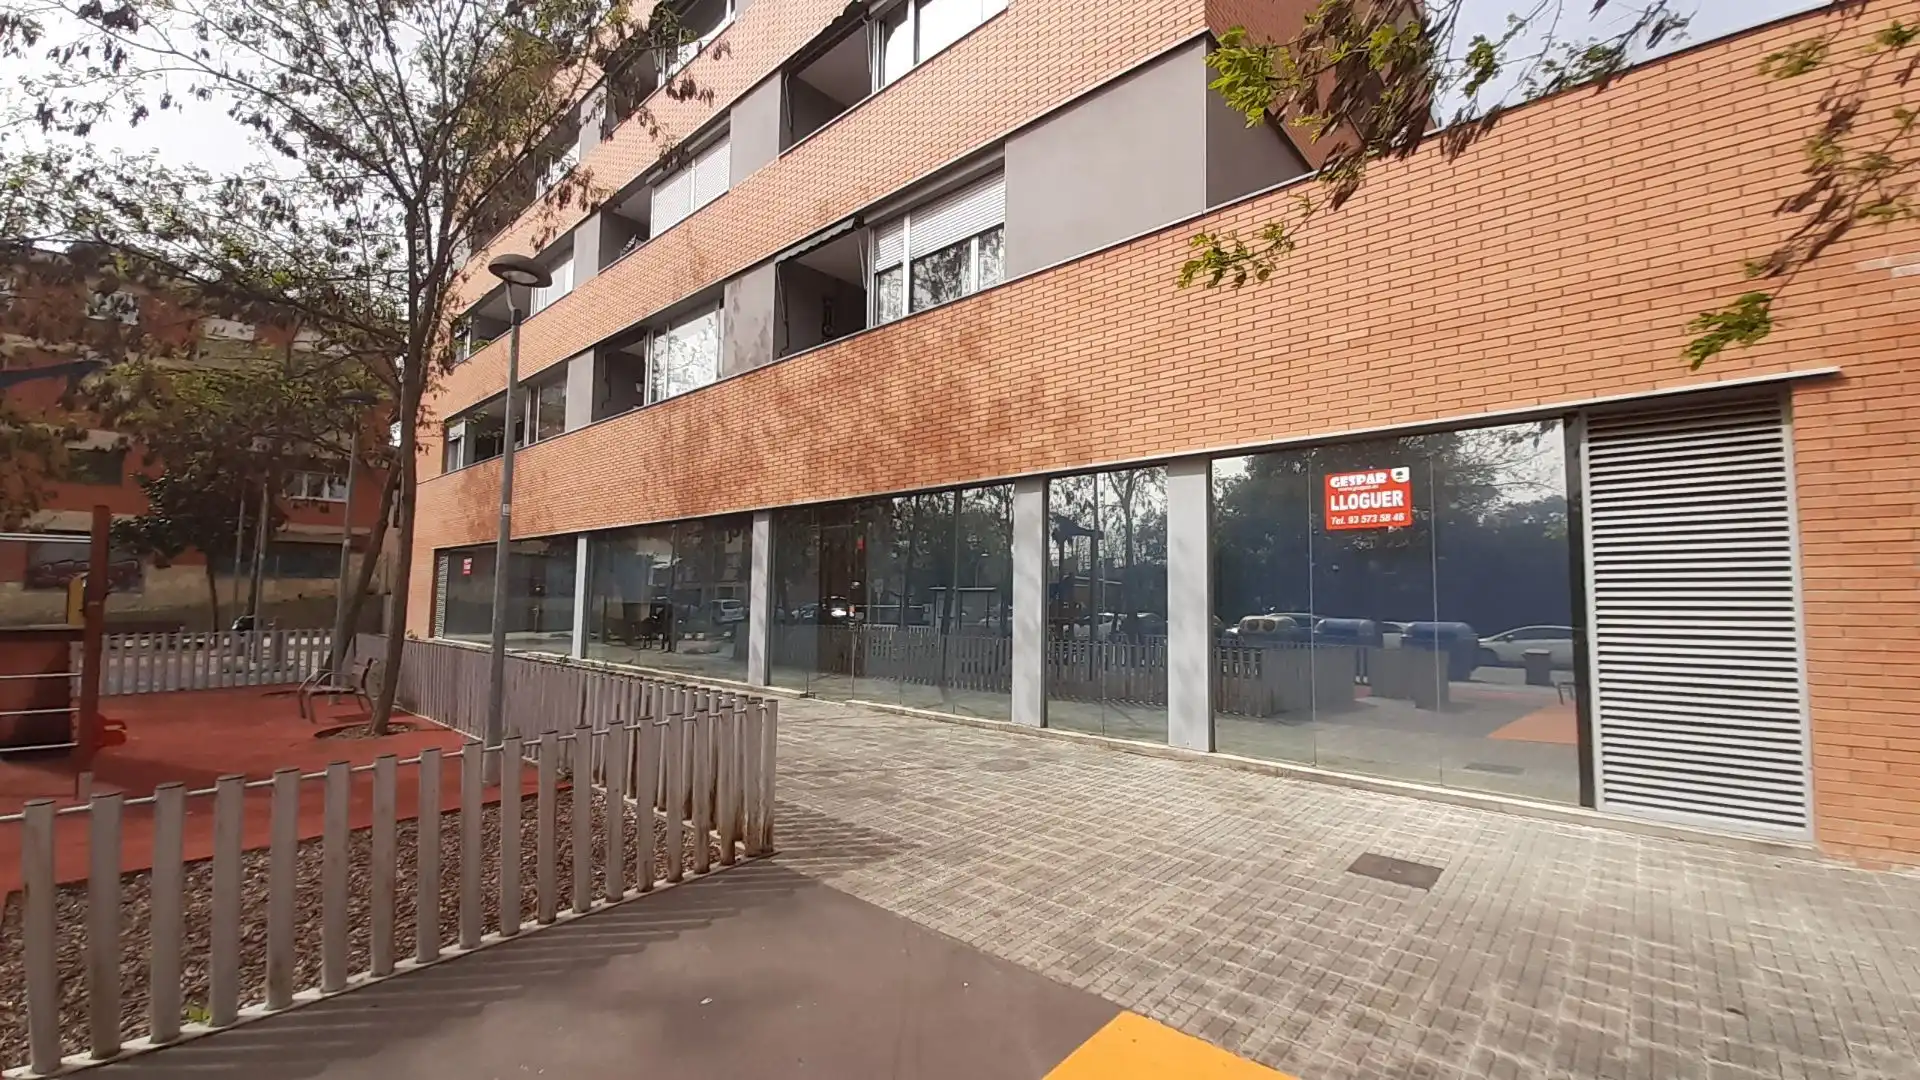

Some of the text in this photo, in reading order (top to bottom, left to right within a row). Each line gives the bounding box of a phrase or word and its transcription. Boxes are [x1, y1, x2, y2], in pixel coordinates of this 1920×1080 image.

[1330, 472, 1387, 488] GESPAR
[1330, 490, 1404, 511] LLOGUER
[1331, 516, 1346, 525] Tel.
[1348, 515, 1359, 524] 93
[1361, 514, 1378, 523] 573
